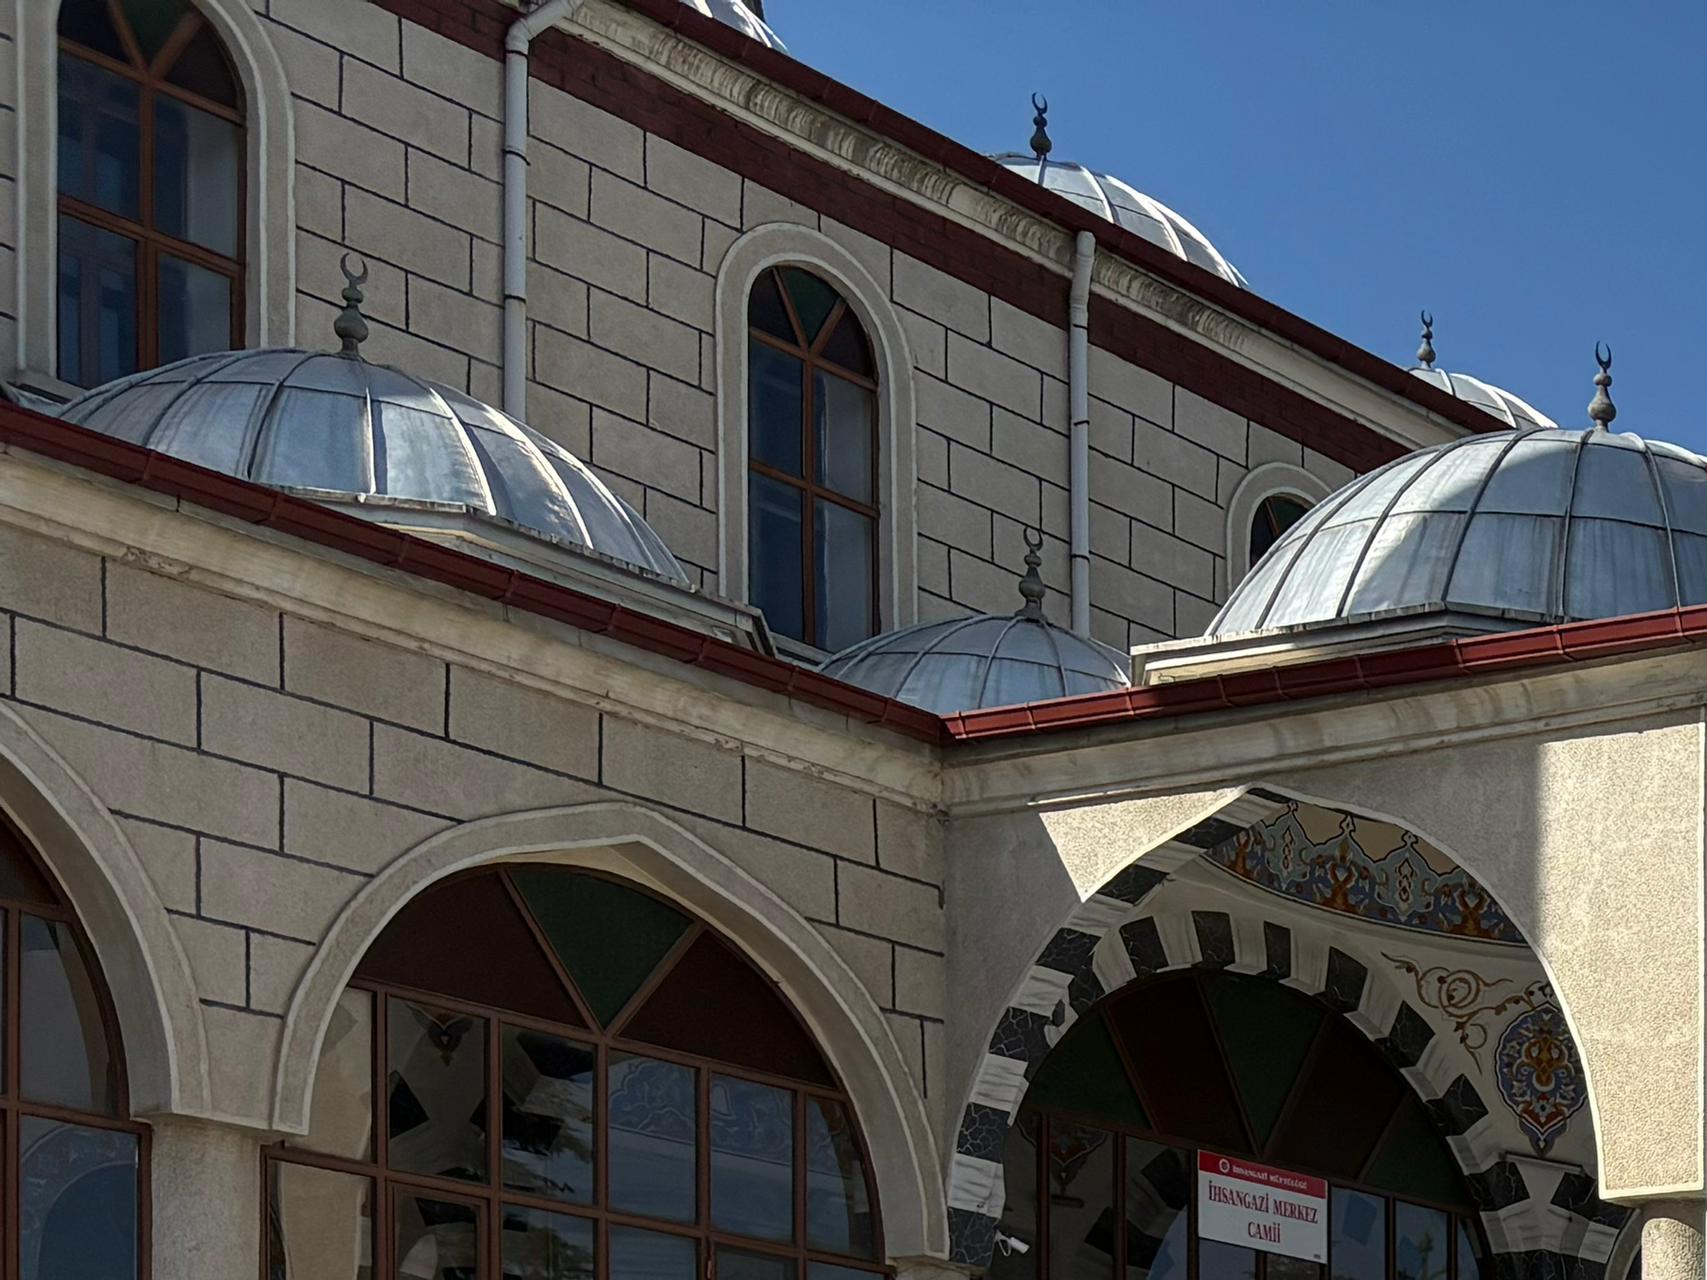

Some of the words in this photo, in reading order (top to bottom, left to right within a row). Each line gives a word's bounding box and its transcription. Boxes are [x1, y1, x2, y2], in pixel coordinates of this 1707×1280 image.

[1208, 1180, 1269, 1213] İHSANGAZİ
[1273, 1199, 1318, 1224] MERKEZ
[1248, 1221, 1281, 1243] CAMİİ
